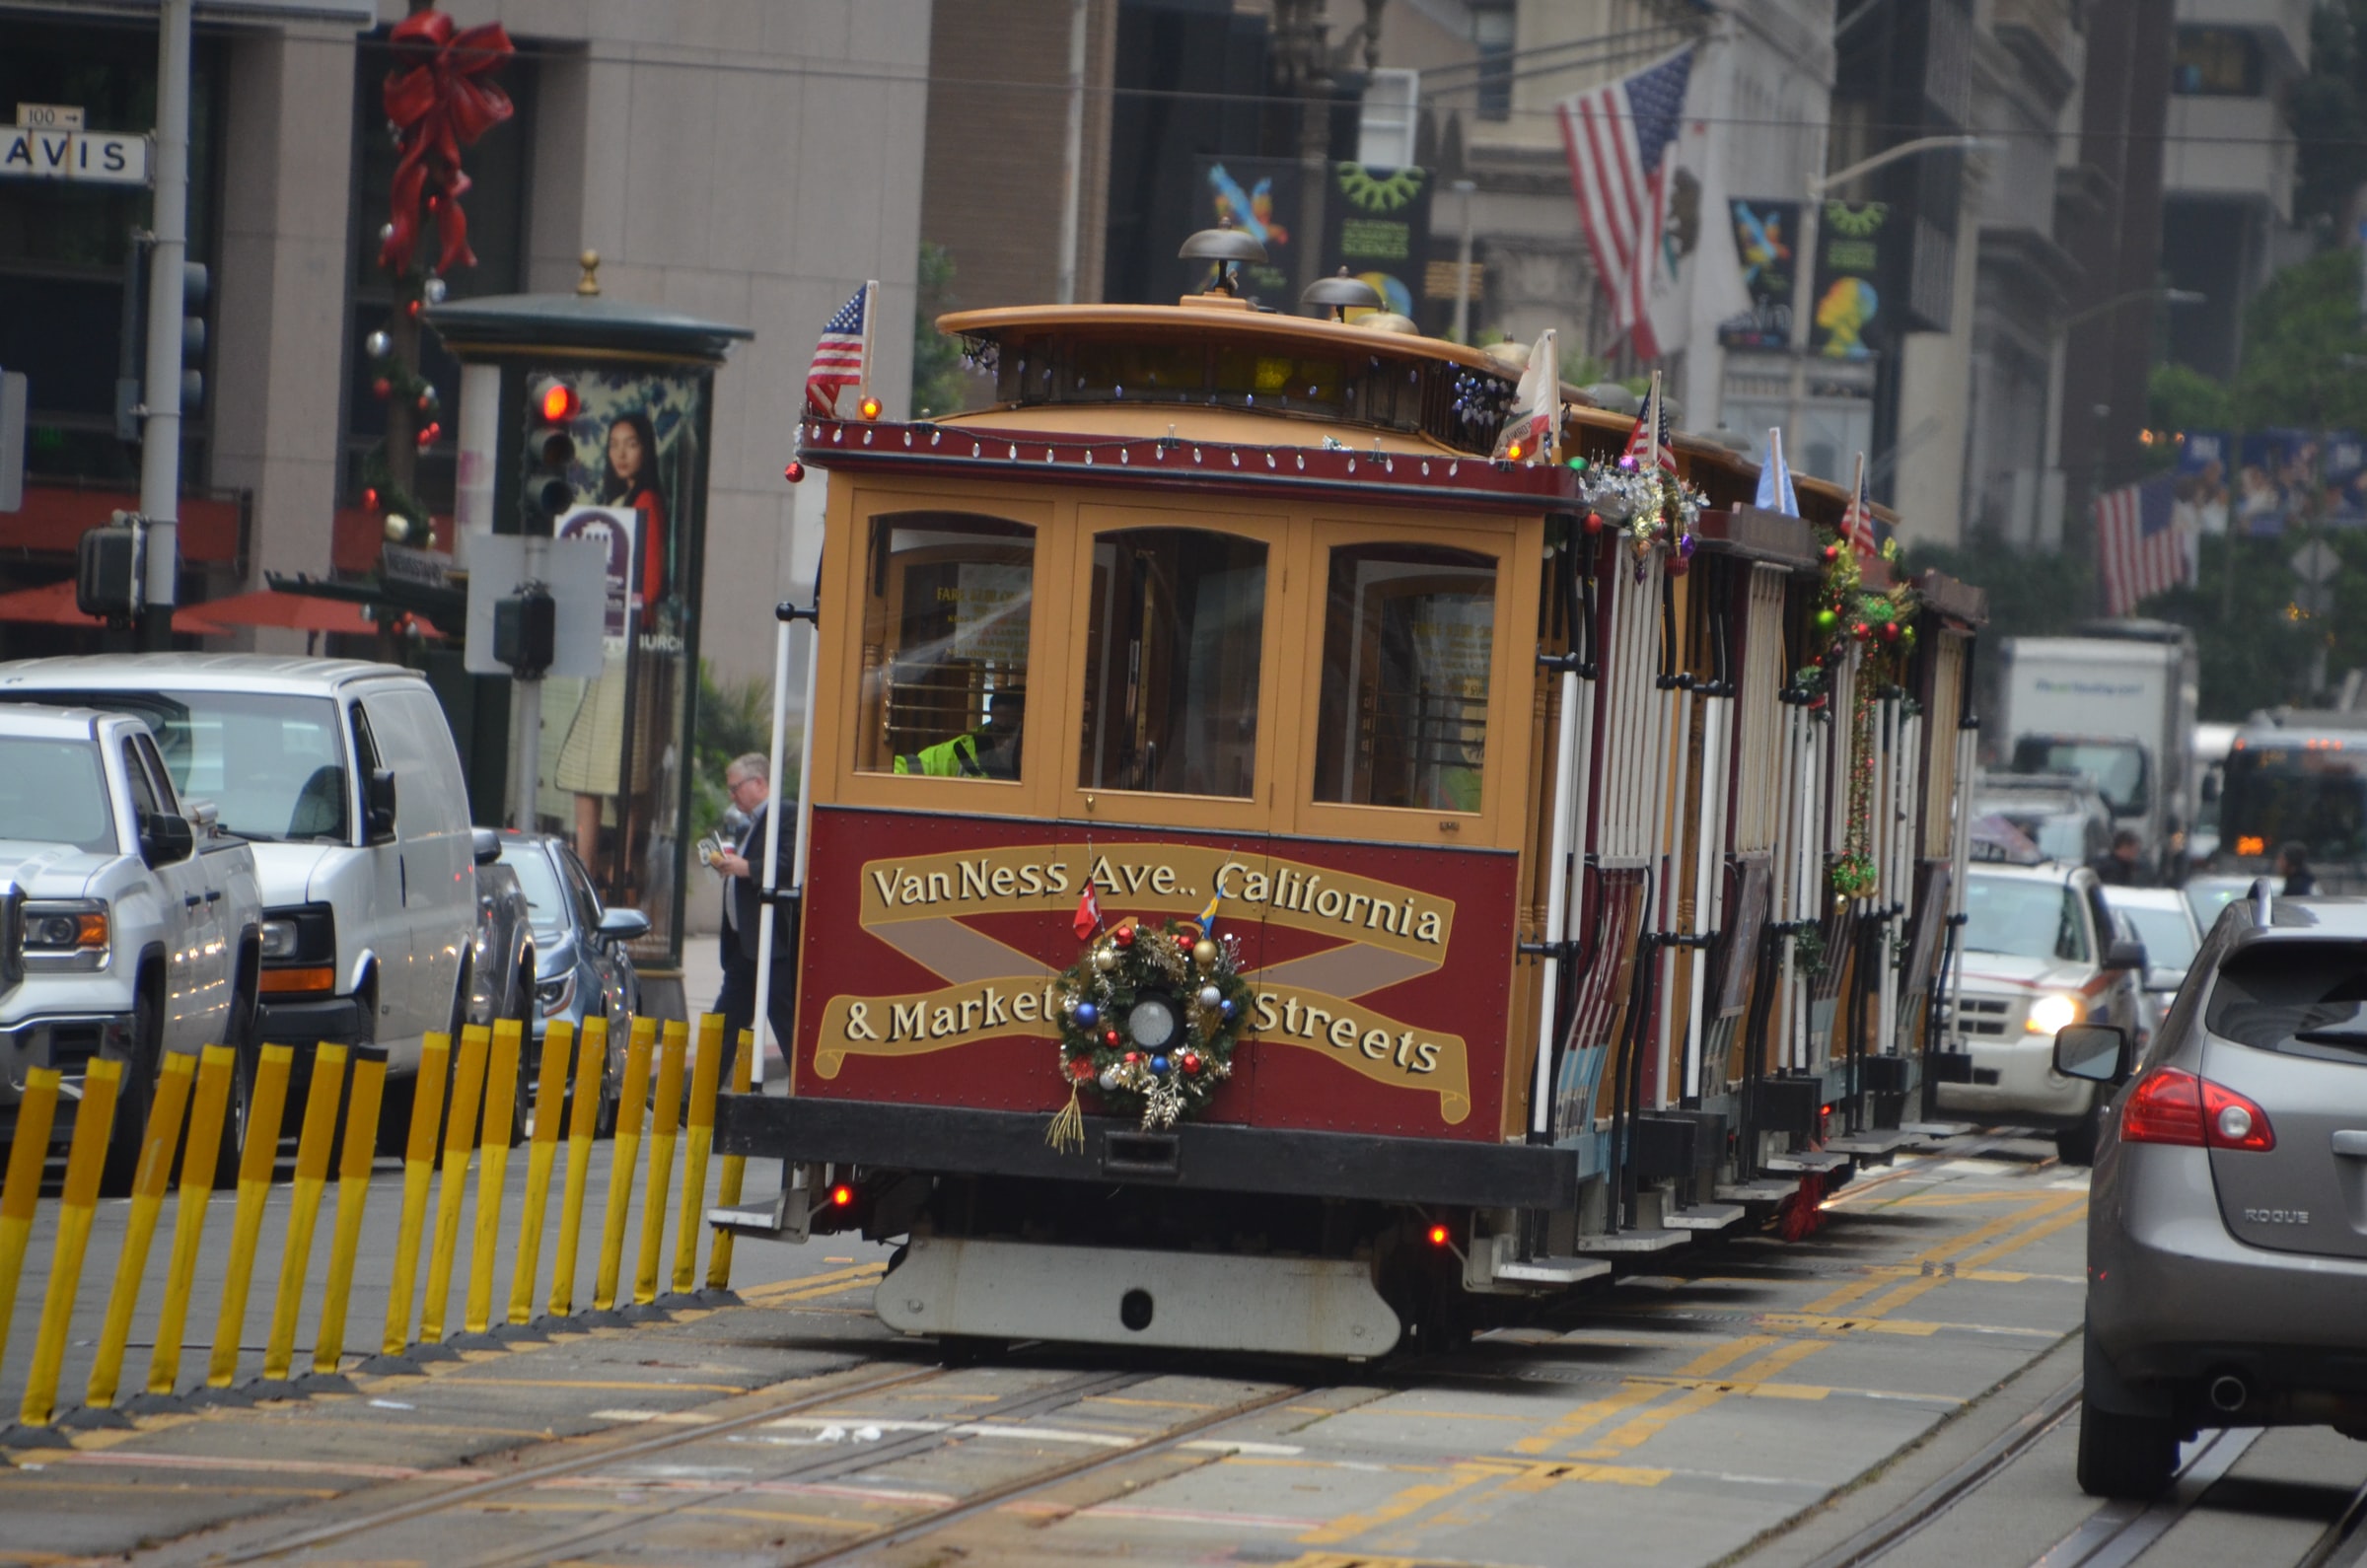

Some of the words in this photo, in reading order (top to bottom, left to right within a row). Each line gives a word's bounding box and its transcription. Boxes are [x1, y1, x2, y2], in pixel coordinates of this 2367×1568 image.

[29, 108, 55, 124] 100
[872, 867, 951, 907] Van
[957, 859, 1068, 899] Ness
[1214, 863, 1441, 944] California
[846, 1002, 880, 1041] &
[886, 984, 1055, 1043] Market
[1250, 992, 1442, 1074] Streets
[2245, 1209, 2309, 1224] ROGUE
